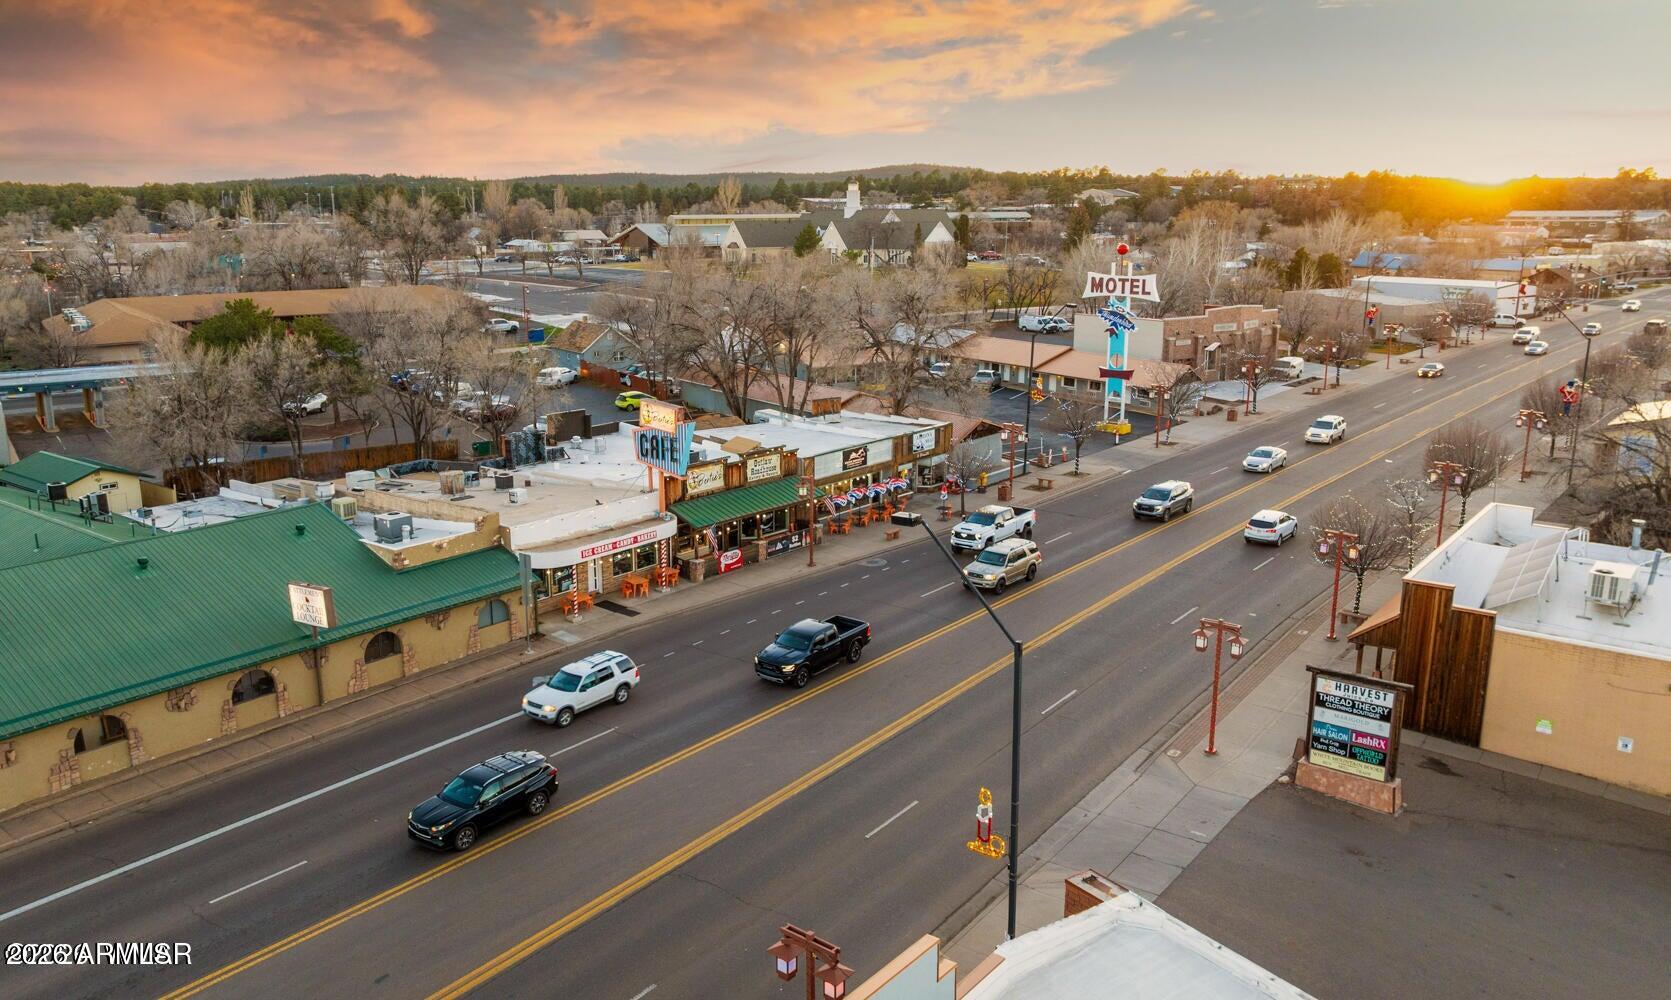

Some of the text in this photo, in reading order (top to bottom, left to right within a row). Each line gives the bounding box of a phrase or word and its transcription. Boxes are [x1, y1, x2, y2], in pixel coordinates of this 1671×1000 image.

[1090, 277, 1151, 295] MOTEL
[640, 433, 678, 463] CAFE
[582, 548, 593, 558] ICE
[594, 543, 613, 554] CREAM
[616, 538, 634, 548] CANDY
[1335, 682, 1388, 701] HARVEST
[1319, 693, 1389, 715] THREAD THEORY
[1325, 702, 1380, 719] CLOTHING BOUTIQUE
[1312, 727, 1327, 737] HAIR
[1328, 730, 1348, 742] SALON
[1352, 733, 1386, 750] LashRX
[1313, 741, 1328, 751] Yarn
[1328, 745, 1346, 756] Shop
[1356, 753, 1379, 765] TATTOO
